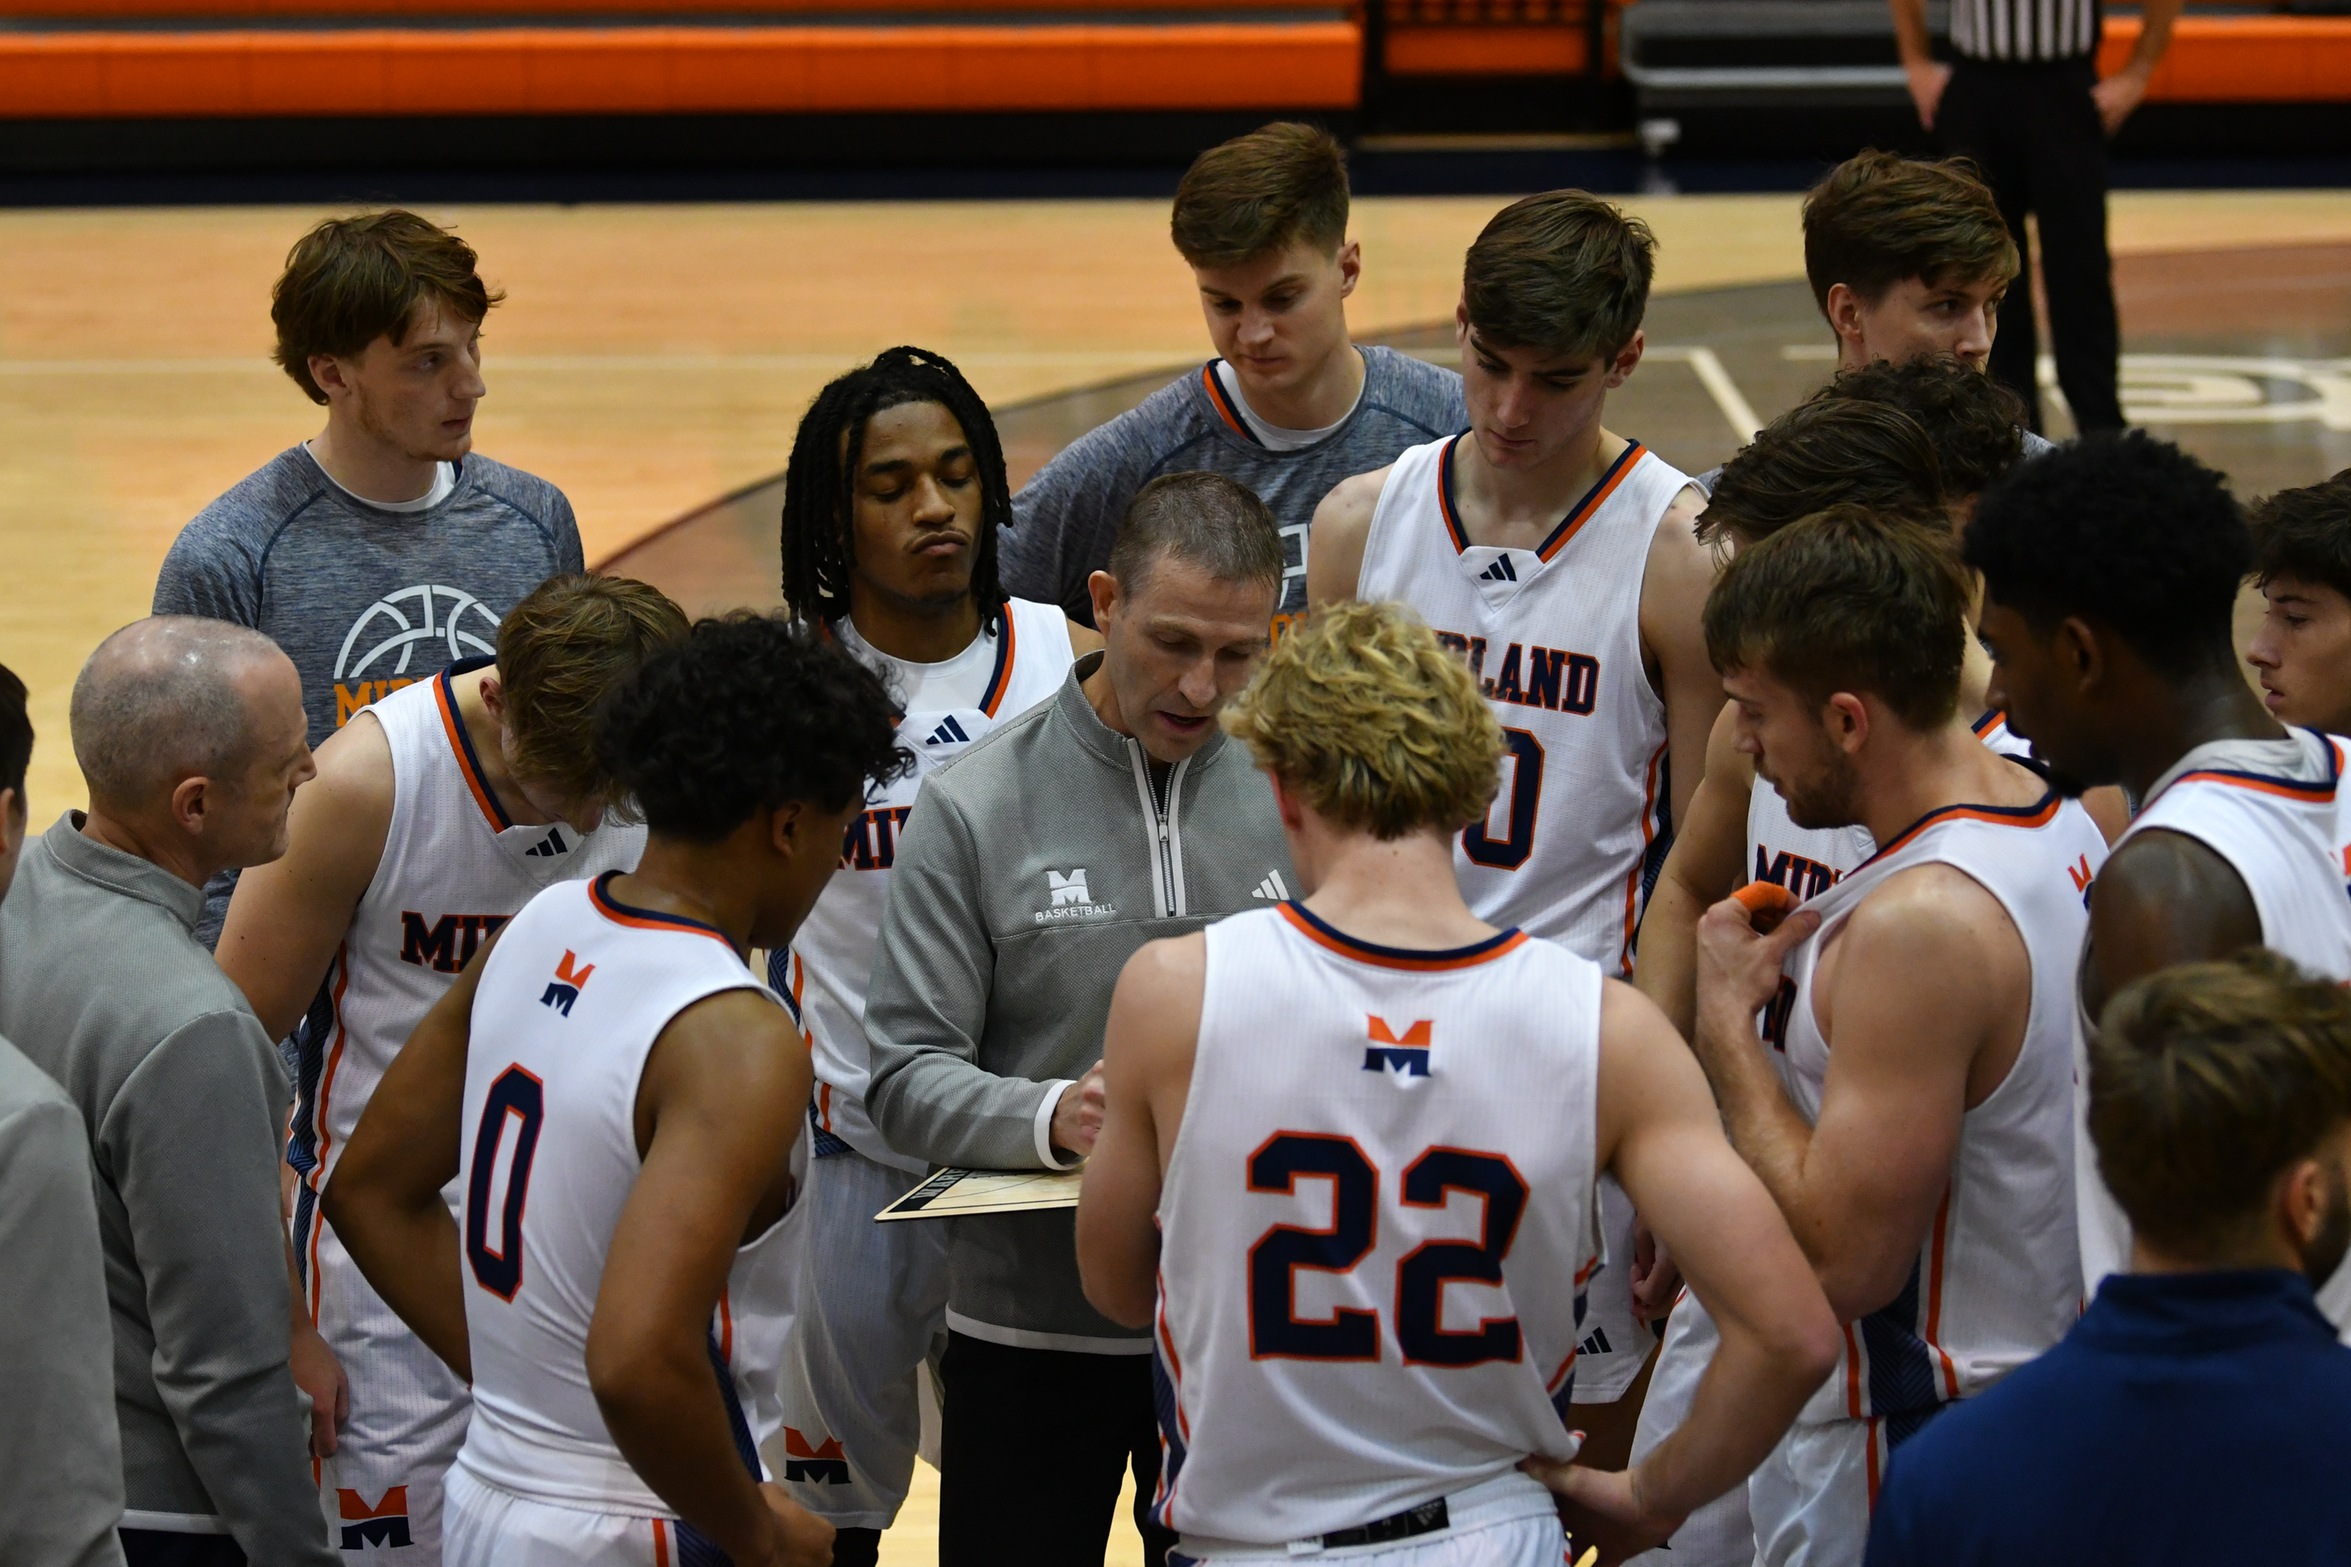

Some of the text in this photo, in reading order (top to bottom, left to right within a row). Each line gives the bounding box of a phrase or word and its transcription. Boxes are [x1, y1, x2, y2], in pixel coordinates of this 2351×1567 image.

[333, 676, 424, 728] MI
[838, 806, 913, 871] MI
[1046, 868, 1092, 907] M
[1755, 843, 1844, 903] MID
[400, 910, 514, 974] MI
[1035, 903, 1117, 922] BASKETBALL
[539, 948, 596, 1018] M
[1361, 1013, 1434, 1077] M
[466, 1061, 544, 1305] 0
[1246, 1129, 1531, 1370] 22
[783, 1425, 853, 1485] M
[335, 1484, 415, 1550] M
